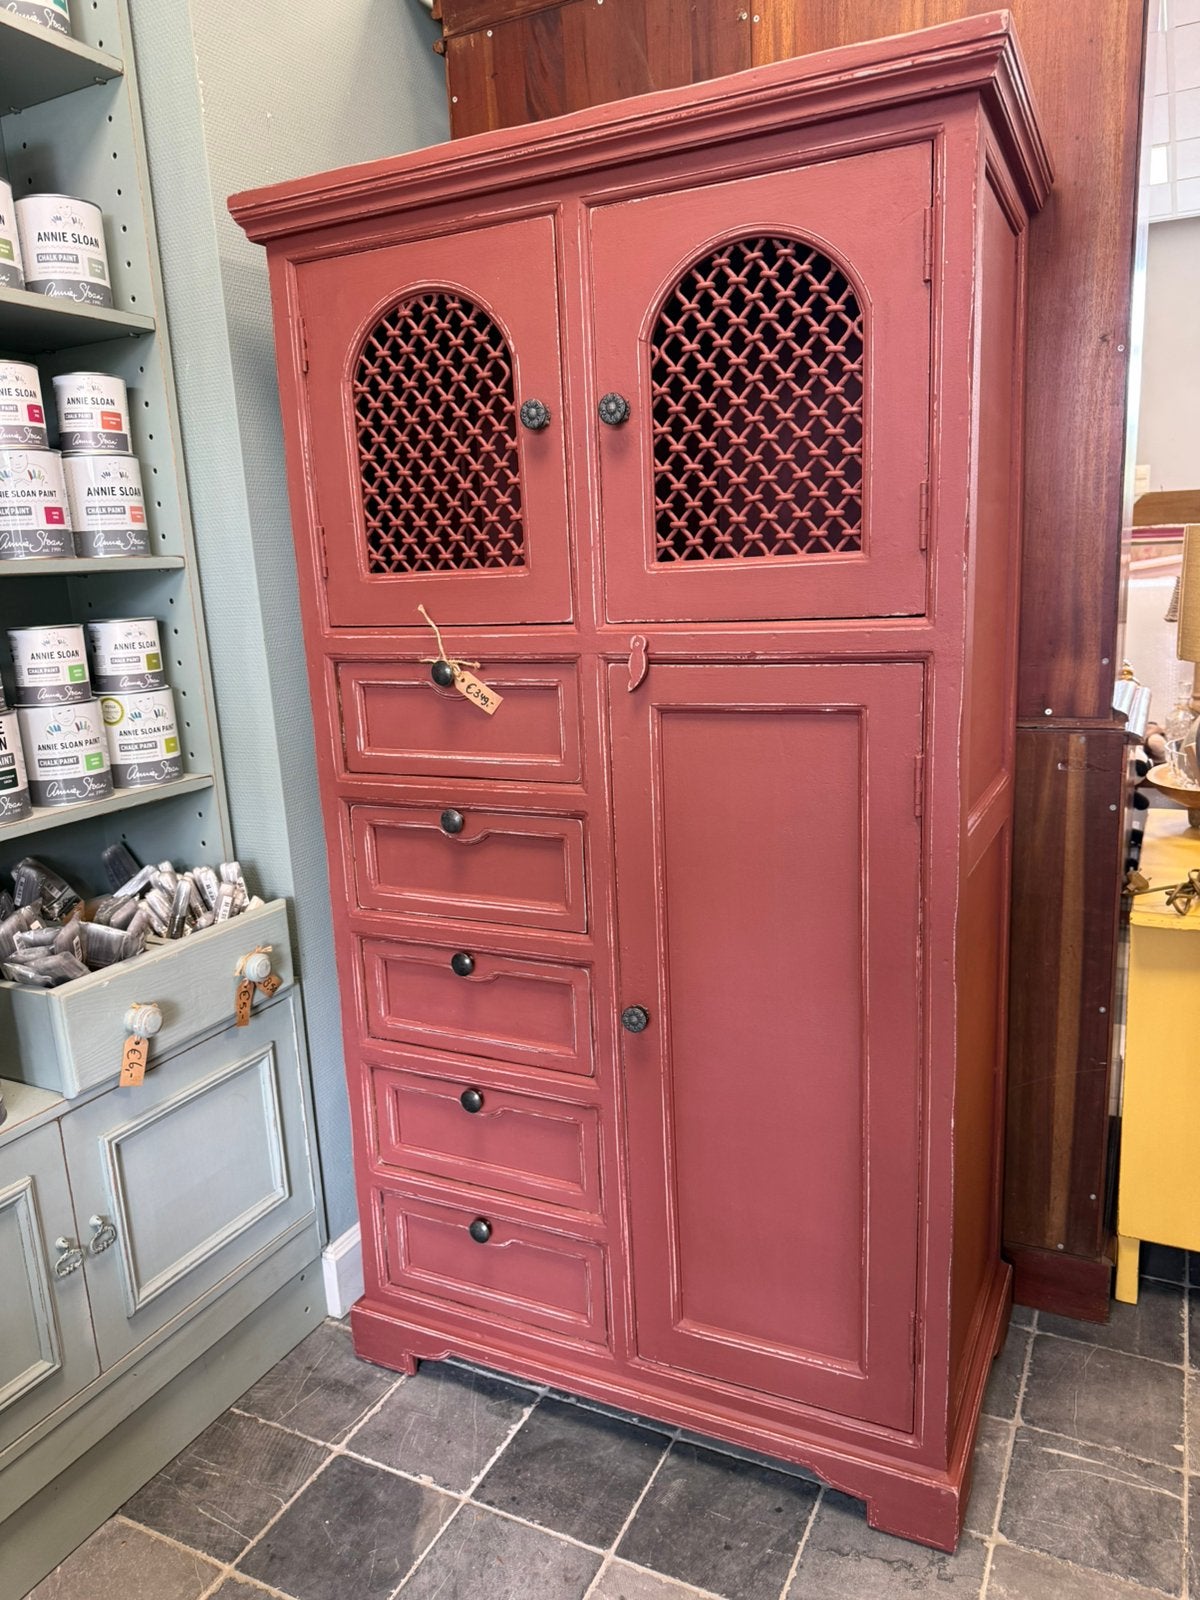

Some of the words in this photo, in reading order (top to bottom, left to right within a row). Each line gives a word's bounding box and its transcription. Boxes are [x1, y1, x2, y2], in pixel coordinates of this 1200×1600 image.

[37, 232, 69, 243] ANNIE
[71, 232, 100, 249] SLOAN
[38, 254, 58, 263] CHALK
[58, 254, 77, 263] PAINT
[73, 282, 104, 303] Sloan
[15, 387, 37, 399] SLOAN
[67, 396, 89, 406] ANNIE
[90, 397, 115, 406] SLOAN
[11, 489, 37, 498] SLOAN
[38, 489, 57, 498] PAINT
[87, 486, 117, 497] ANNIE
[10, 506, 30, 514] PAINT
[87, 507, 107, 515] CHALK
[107, 506, 124, 514] PAINT
[29, 530, 64, 552] Sloan
[114, 641, 137, 650] ANNIE
[138, 640, 157, 649] SLOAN
[31, 651, 55, 660] ANNIE
[57, 649, 80, 659] SLOAN
[119, 729, 139, 737] ANNIE
[140, 726, 161, 735] SLOAN
[38, 743, 58, 751] ANNIE
[60, 740, 83, 750] SLOAN
[85, 736, 100, 745] PAINT
[120, 743, 139, 751] CHALK
[40, 759, 59, 767] CHALK
[59, 757, 77, 765] PAINT
[76, 776, 106, 798] Sloan
